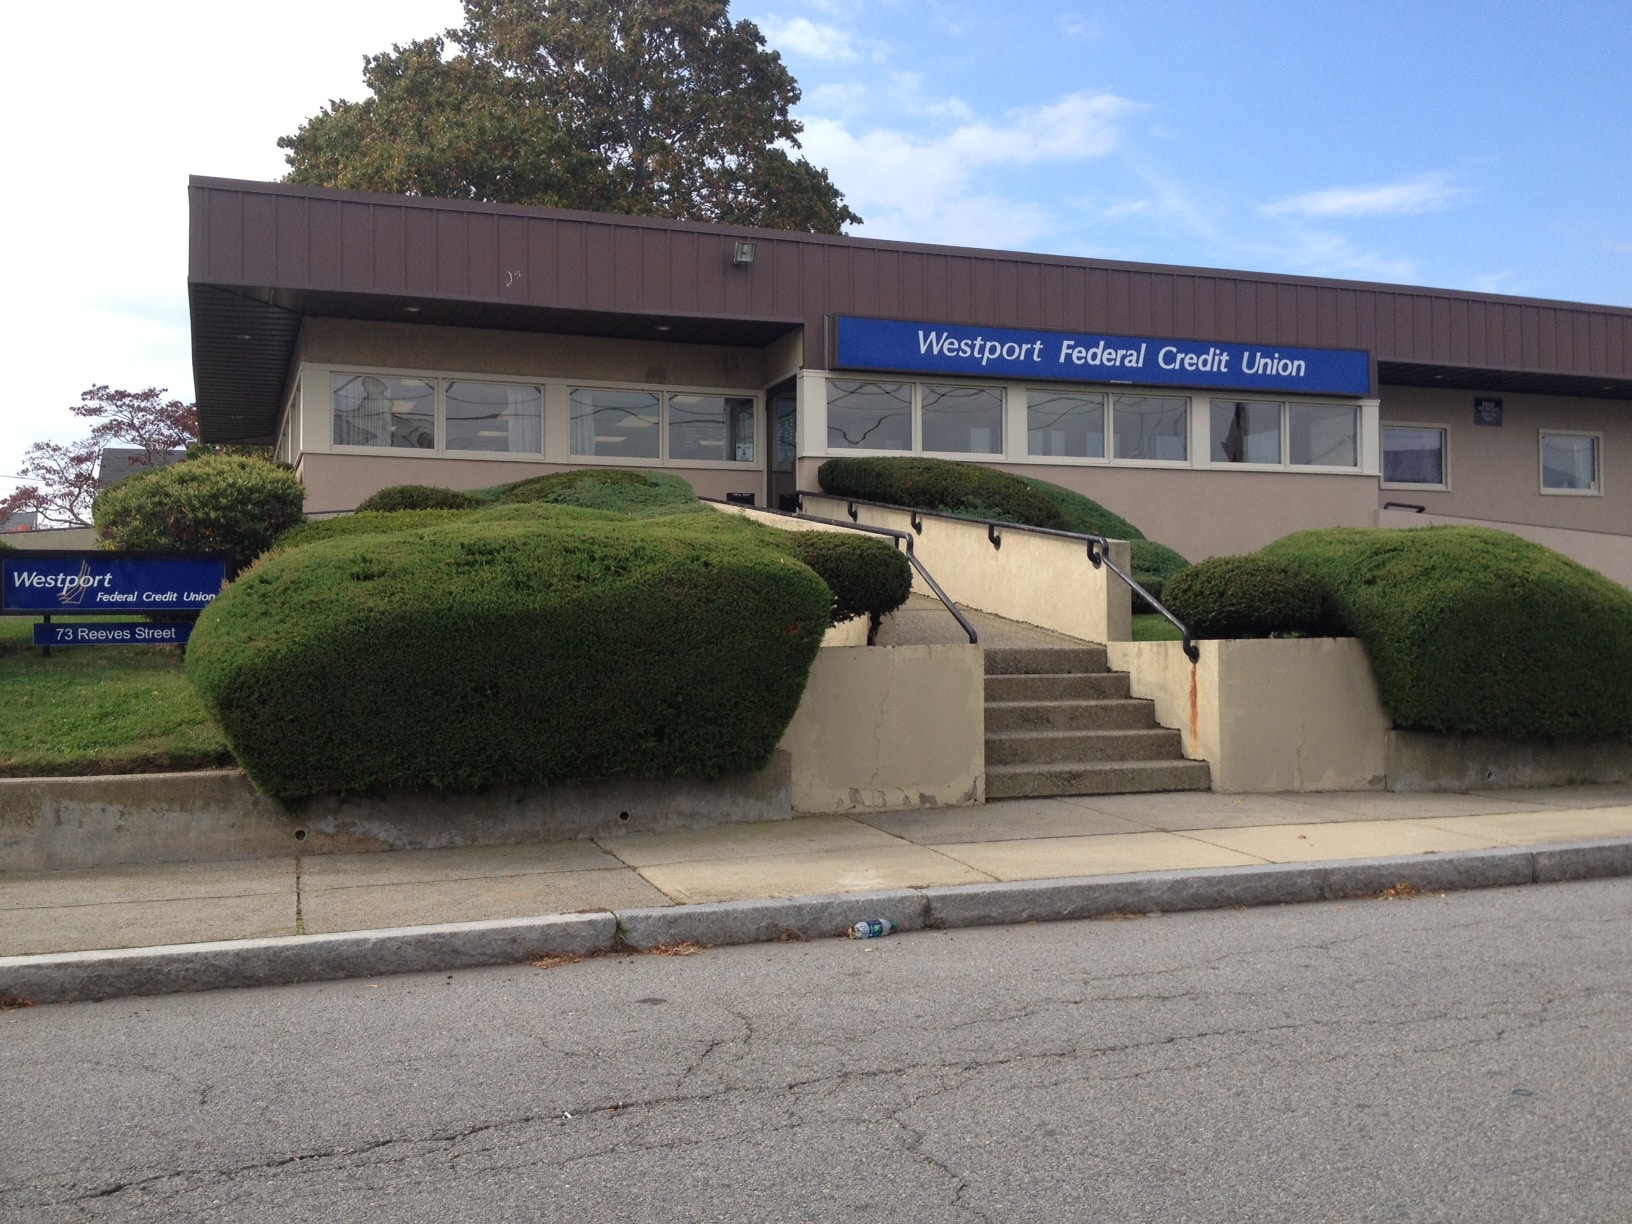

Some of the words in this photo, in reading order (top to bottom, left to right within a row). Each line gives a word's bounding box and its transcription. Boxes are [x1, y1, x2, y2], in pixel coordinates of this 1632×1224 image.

[917, 330, 1043, 366] Westport
[1058, 340, 1146, 368] Federal
[1158, 346, 1229, 372] Credit
[1241, 351, 1305, 376] Union
[13, 571, 113, 594] Westport
[96, 591, 137, 602] Federal
[143, 591, 178, 602] Credit
[183, 591, 216, 602] Union
[56, 628, 73, 640] 73
[78, 628, 131, 640] Reeves
[135, 627, 176, 639] Street
